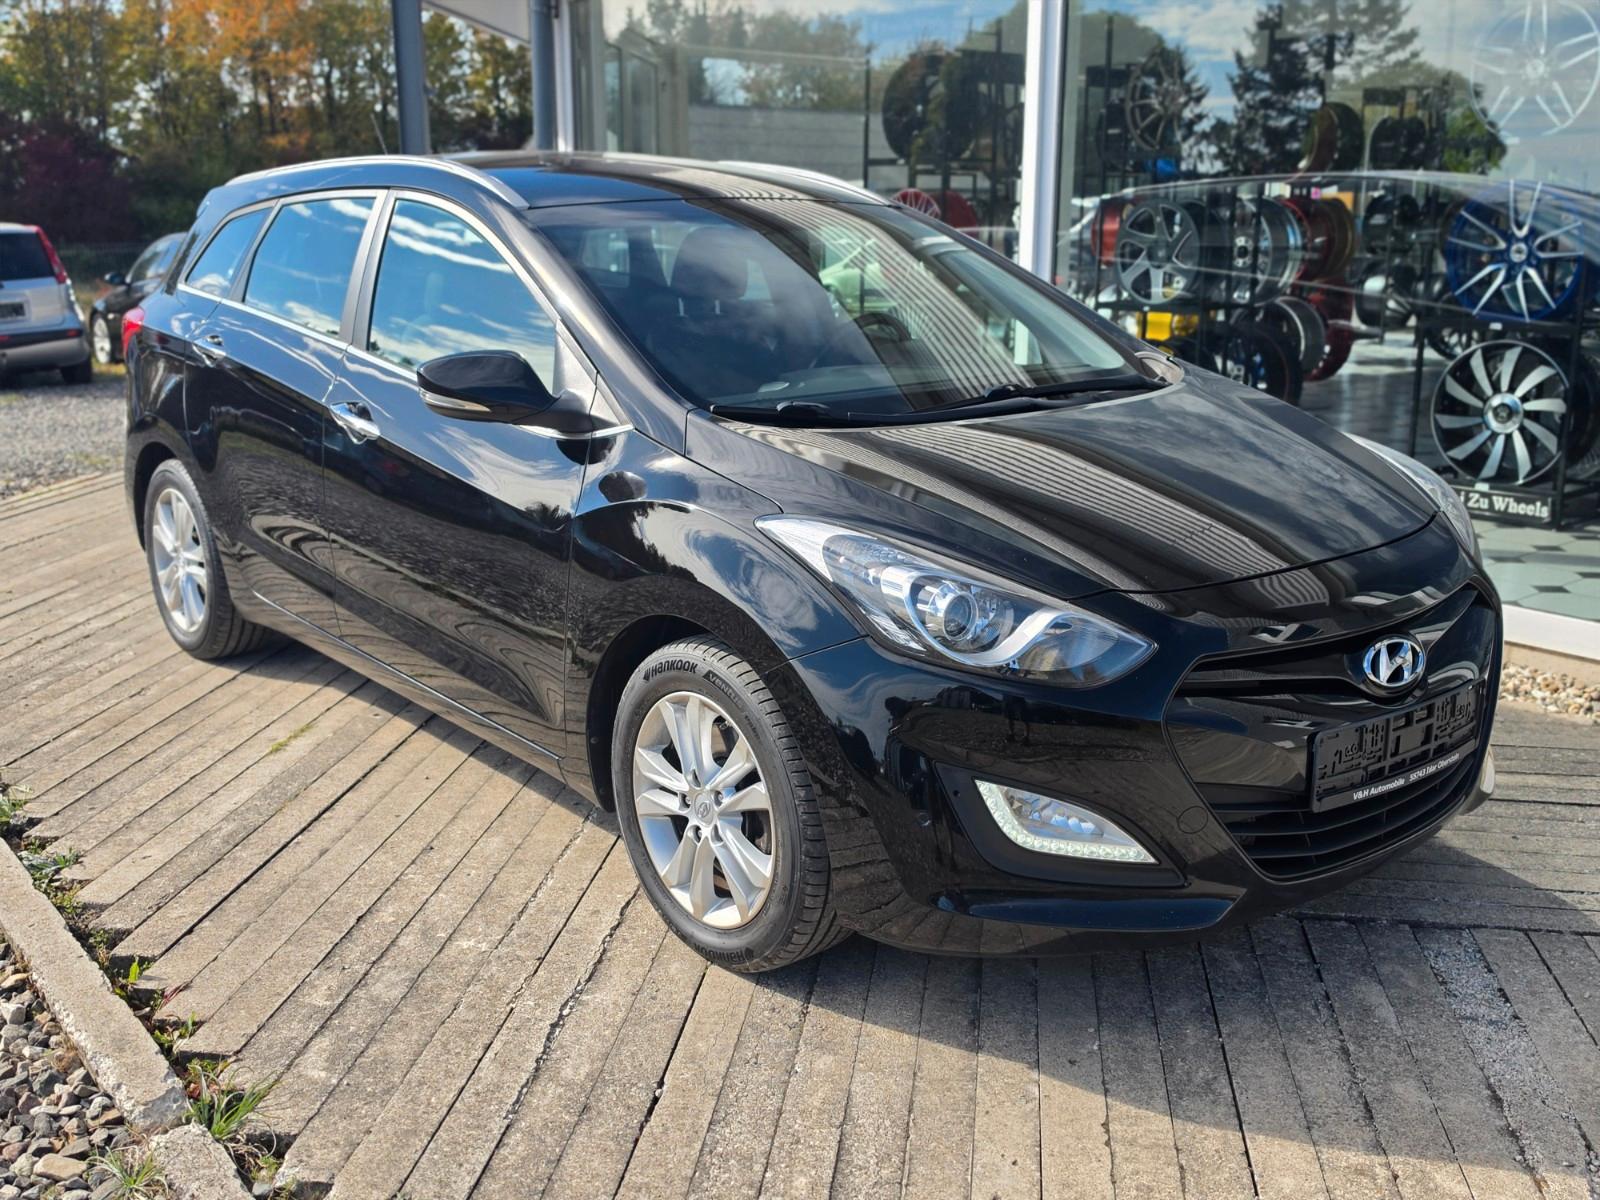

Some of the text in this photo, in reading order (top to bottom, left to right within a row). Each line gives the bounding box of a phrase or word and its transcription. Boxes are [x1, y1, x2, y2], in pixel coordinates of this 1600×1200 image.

[1467, 492, 1488, 509] Zu
[1491, 495, 1548, 518] Wheels
[1353, 789, 1369, 800] V&H
[1370, 778, 1405, 796] Automobile
